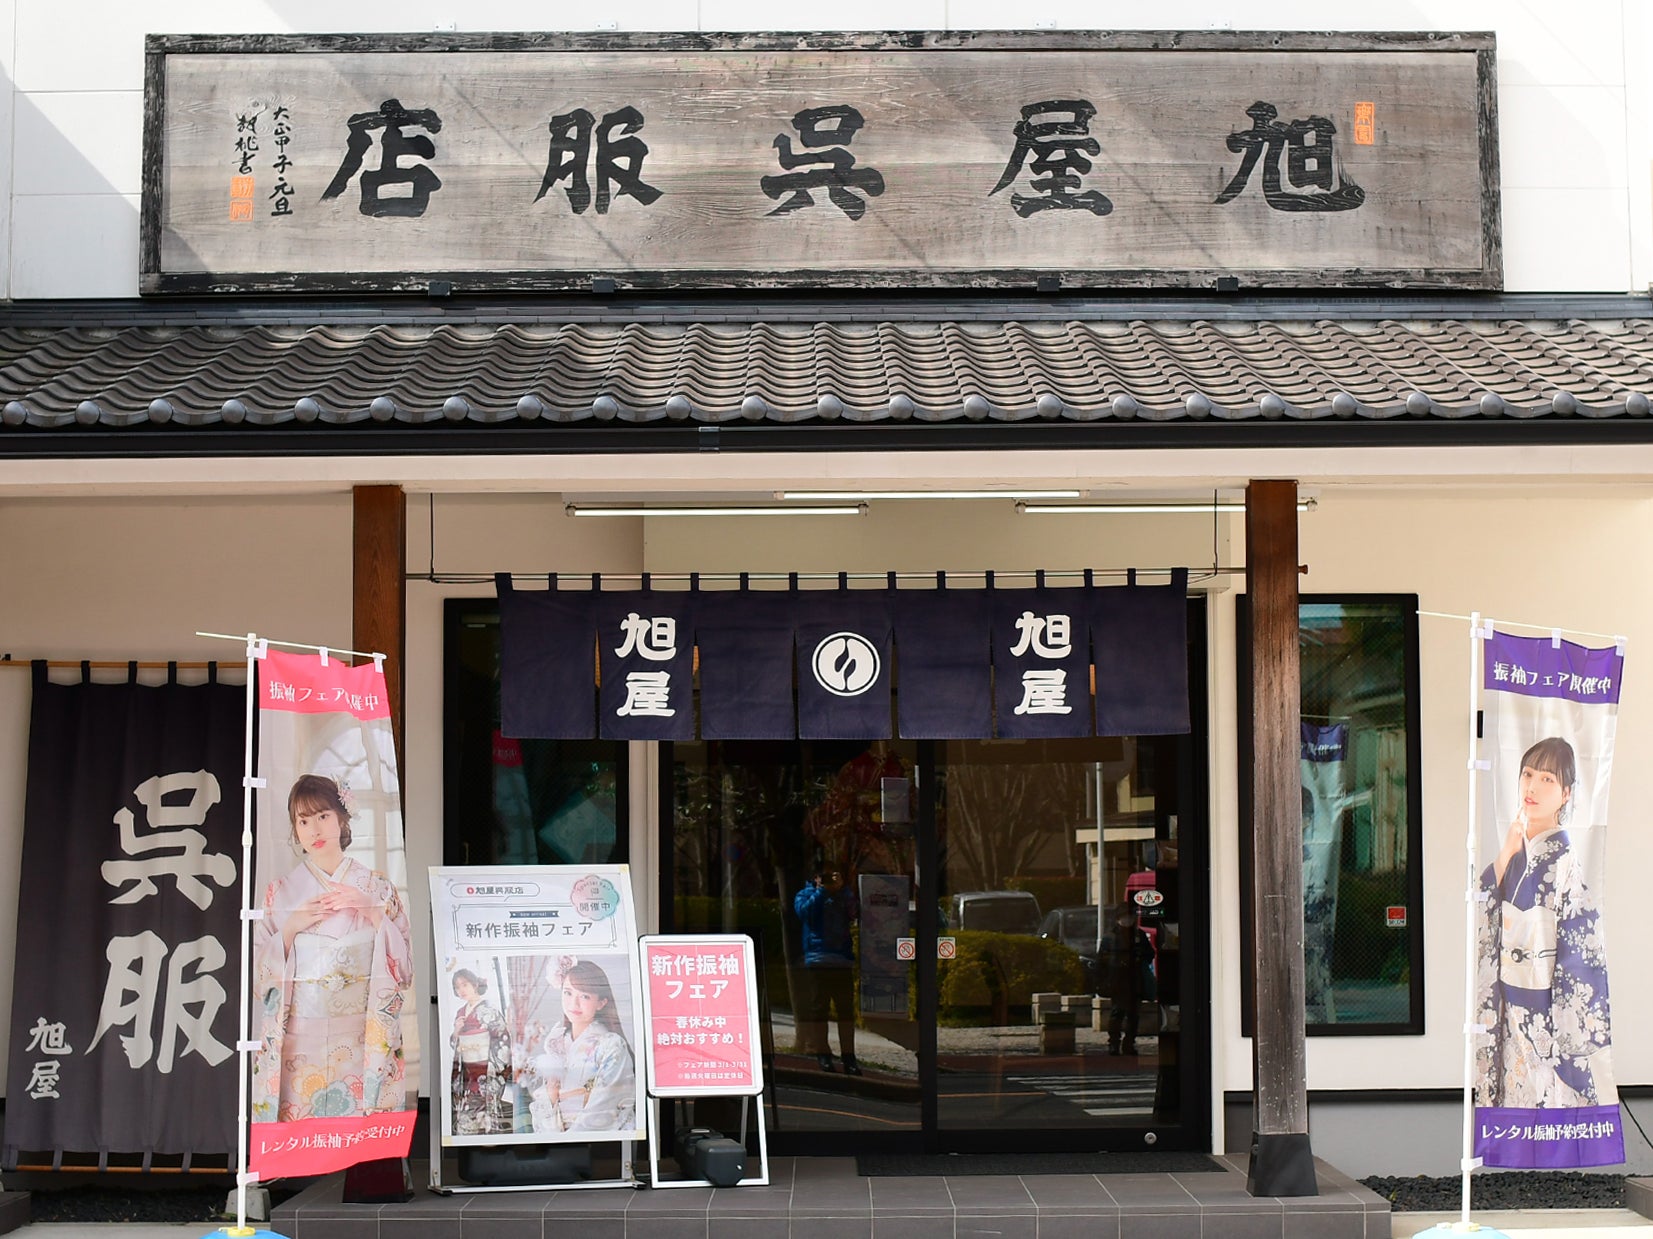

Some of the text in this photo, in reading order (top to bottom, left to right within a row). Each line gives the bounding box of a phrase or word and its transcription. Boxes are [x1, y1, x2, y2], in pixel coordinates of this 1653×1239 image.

[614, 611, 677, 718] 旭屋
[1010, 610, 1074, 716] 旭屋
[85, 769, 237, 1074] 呉服
[466, 921, 593, 939] 新作振袖フェア
[651, 954, 740, 976] 新作振袖
[665, 979, 729, 999] フェア
[675, 1016, 727, 1029] 春休み中
[657, 1032, 744, 1046] 絶対おすすめ！
[25, 1017, 73, 1100] 旭屋
[1481, 1121, 1614, 1141] レンタル振袖予約受付中
